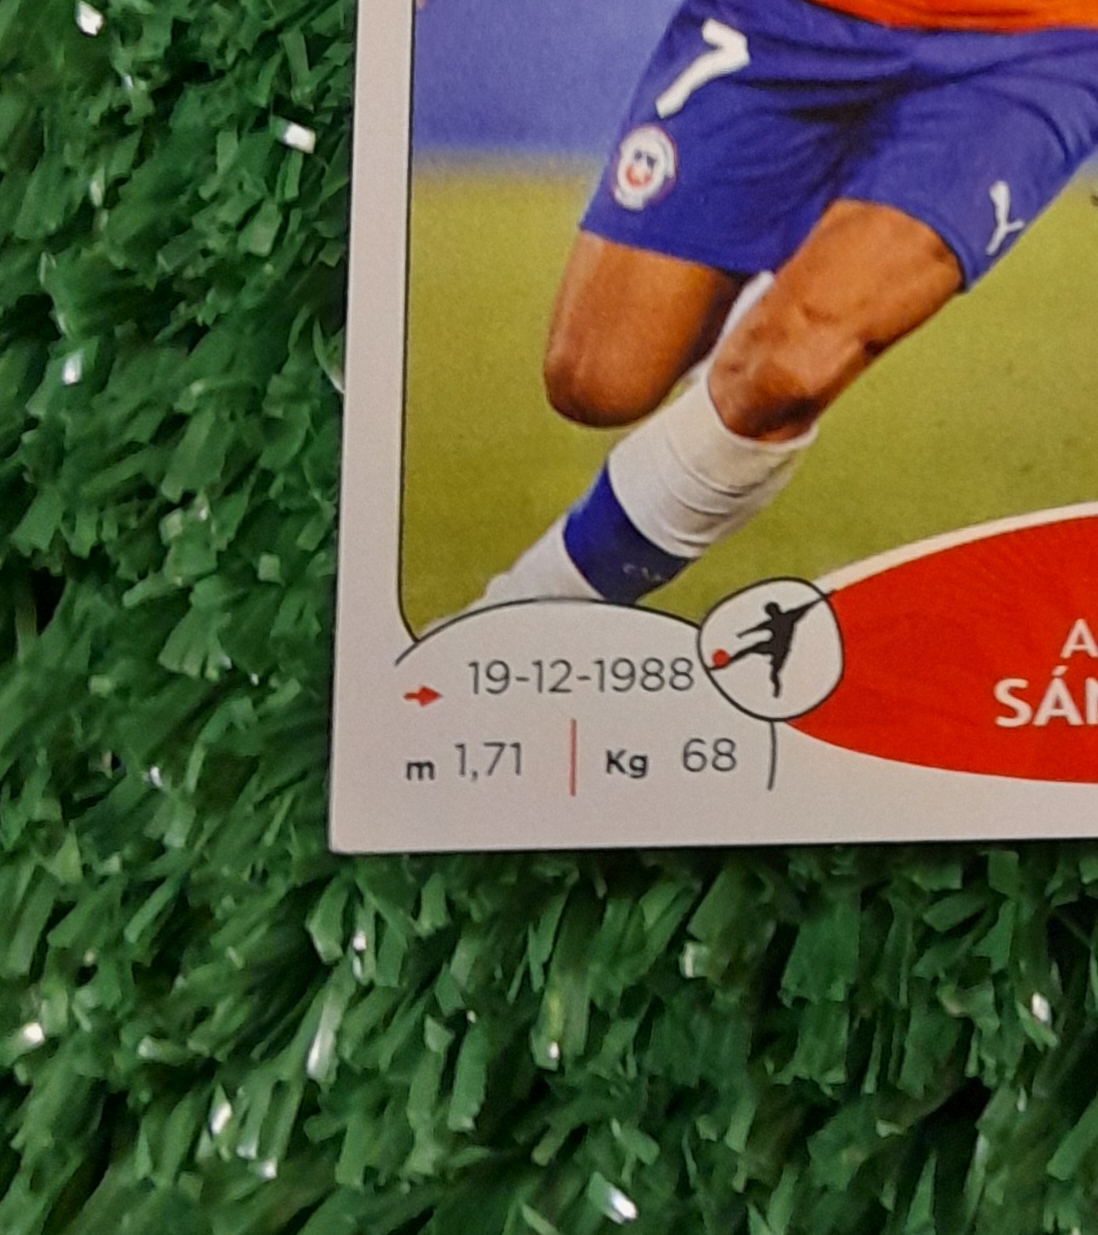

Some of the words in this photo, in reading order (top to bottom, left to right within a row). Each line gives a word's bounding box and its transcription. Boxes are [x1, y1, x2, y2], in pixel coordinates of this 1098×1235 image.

[654, 17, 751, 119] 7
[467, 657, 696, 695] 19-12-1988
[404, 759, 436, 781] m
[453, 740, 523, 781] 1,71
[604, 747, 649, 779] Kg
[680, 737, 738, 773] 68
